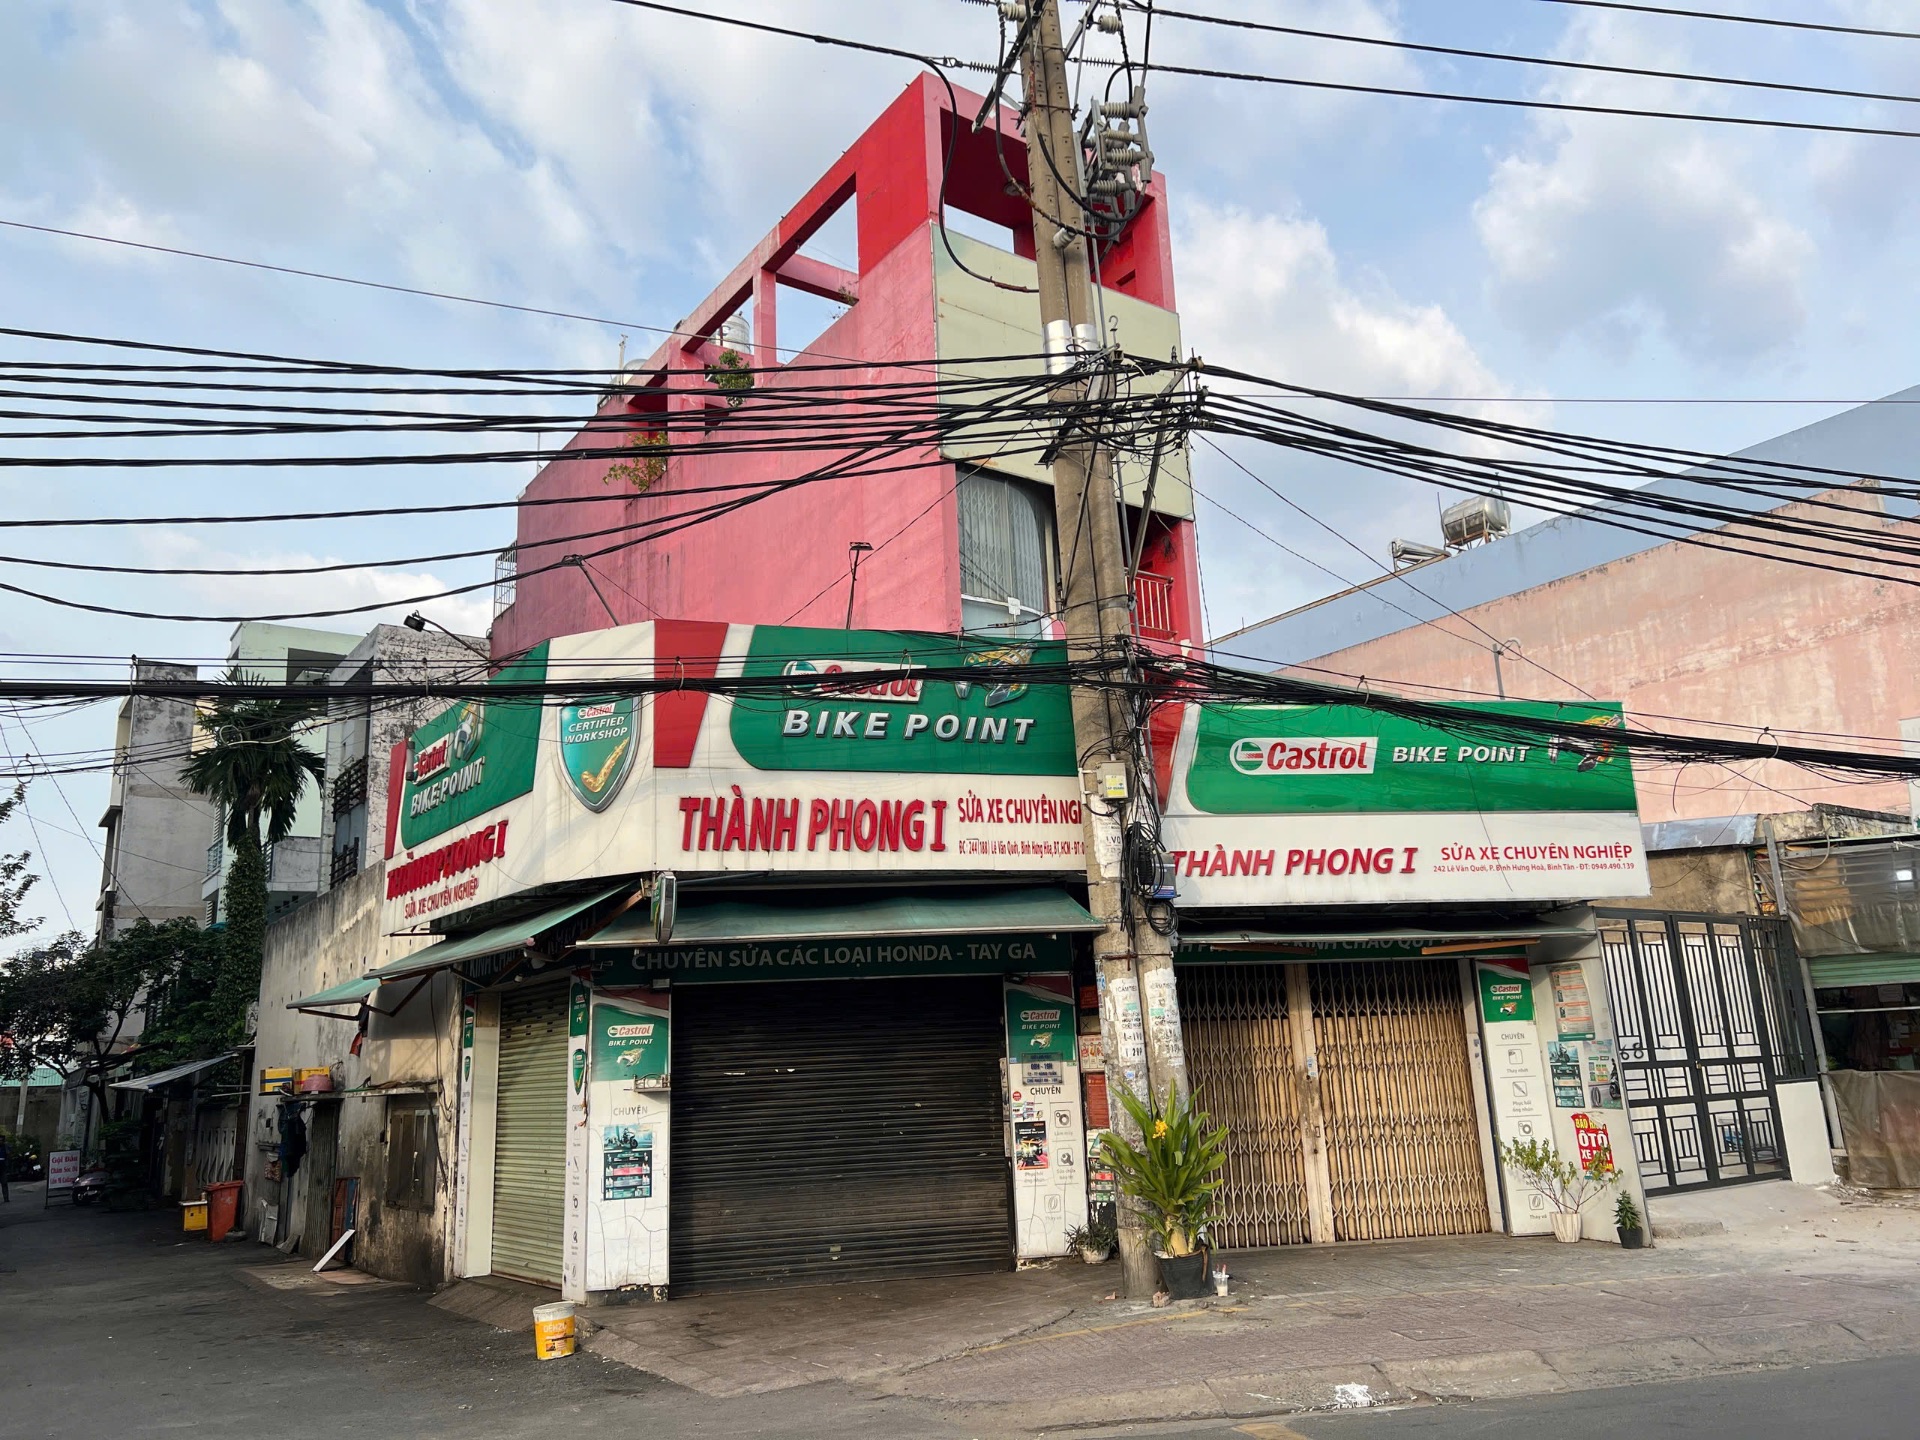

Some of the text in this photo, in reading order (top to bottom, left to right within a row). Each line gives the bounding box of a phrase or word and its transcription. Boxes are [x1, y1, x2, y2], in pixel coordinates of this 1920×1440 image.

[568, 716, 625, 733] CERTIFIED
[783, 709, 1035, 743] BIKE POINT
[565, 727, 628, 744] WORKSHOP
[1267, 741, 1529, 771] Castrol BIKE POINT
[439, 756, 486, 808] POINT
[958, 790, 984, 823] SỬA
[987, 798, 1003, 823] XE
[1006, 794, 1058, 824] CHUYÊN
[680, 785, 948, 853] THÀNH PHONG I
[1441, 842, 1633, 861] SỬA XE CHUYÊN NGHIỆP
[1170, 844, 1418, 877] THÀNH PHONG I
[1456, 864, 1468, 872] Văn
[1489, 864, 1495, 872] P.
[1512, 864, 1530, 872] Hưng
[1592, 862, 1635, 870] 0949.490.139
[632, 948, 722, 970] CHUYÊN
[729, 944, 773, 967] SỬA
[776, 944, 818, 966] CÁC
[824, 946, 872, 968] LOẠI
[877, 945, 952, 963] HONDA
[968, 944, 1003, 960] TAY
[1008, 942, 1036, 959] GA
[1030, 1011, 1058, 1020] Castrol
[619, 1026, 651, 1036] Castrol
[1501, 1032, 1525, 1040] CHUYÊN
[629, 1038, 654, 1046] POINT
[1030, 1086, 1061, 1096] CHUYÊN
[613, 1105, 648, 1116] CHUYÊN
[1578, 1129, 1608, 1148] ÔTÔ
[1581, 1149, 1592, 1160] XE
